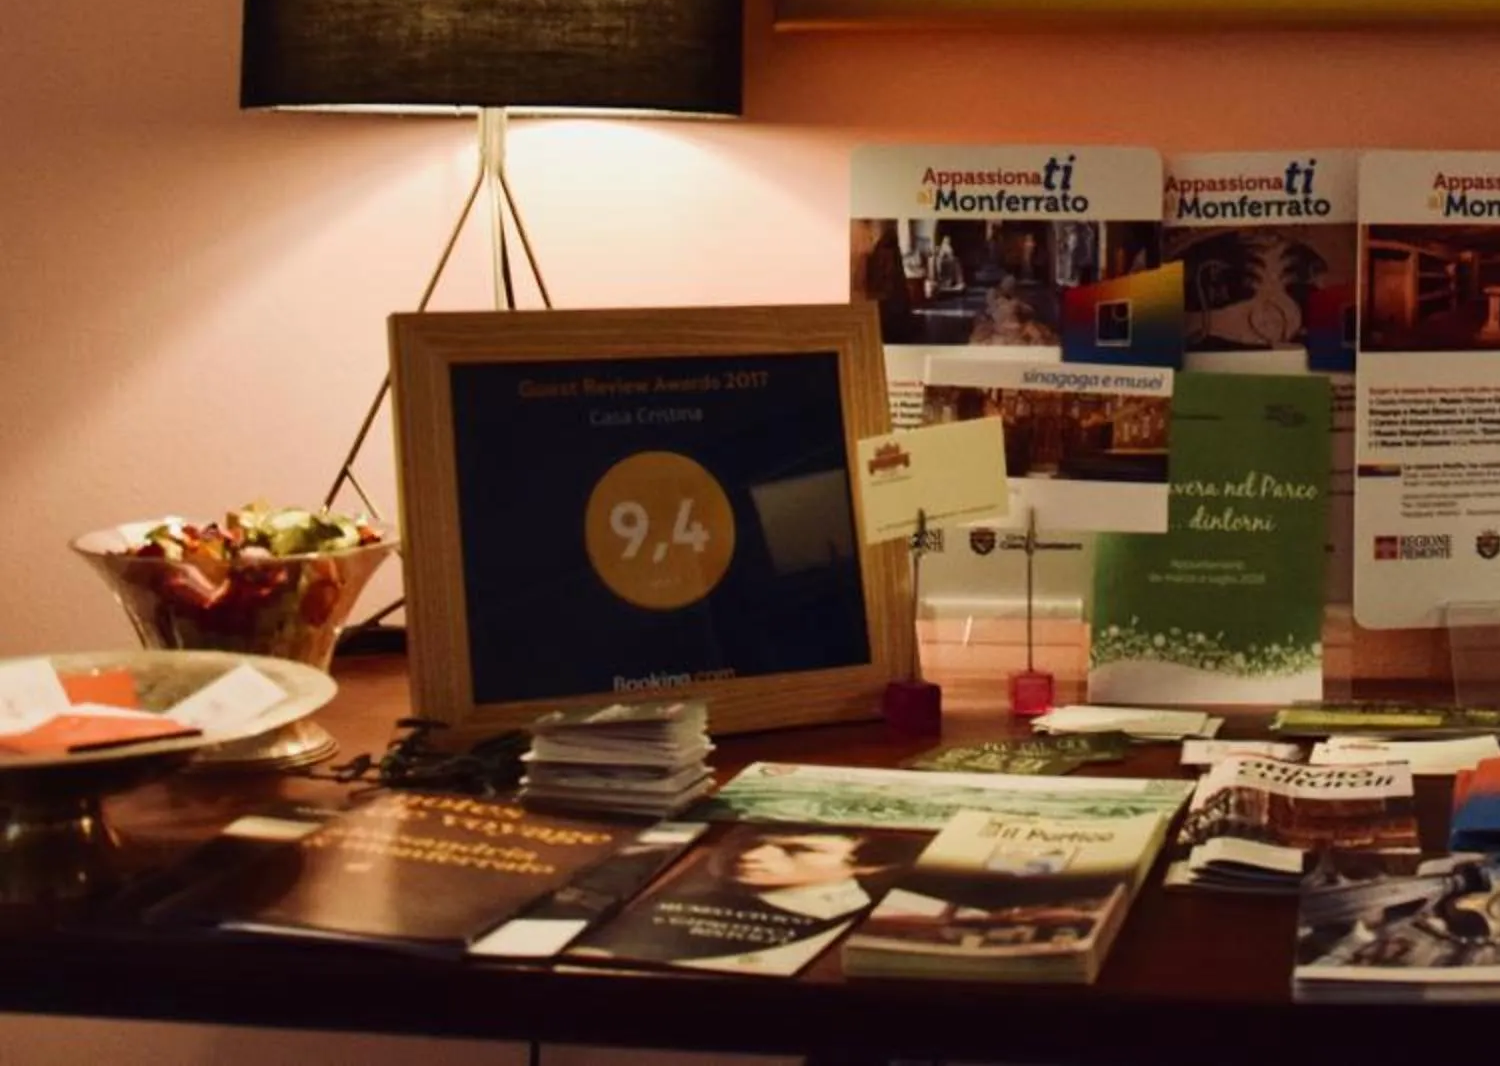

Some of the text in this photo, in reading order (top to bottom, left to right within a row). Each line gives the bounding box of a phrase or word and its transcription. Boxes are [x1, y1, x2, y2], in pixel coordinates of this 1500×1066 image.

[921, 155, 1078, 191] Appassionati
[1164, 158, 1317, 196] Appassionati
[934, 188, 1089, 214] Monferrato
[1176, 194, 1331, 219] Monferrato
[518, 379, 578, 401] Guest
[583, 377, 648, 397] Review
[654, 372, 721, 393] Awards
[1022, 368, 1164, 390] sinagoga e musei
[589, 403, 704, 427] Casa Cristina
[1223, 470, 1257, 499] nel
[1259, 474, 1318, 500] Parco
[610, 498, 710, 563] 9,4
[1188, 505, 1278, 533] dintorni
